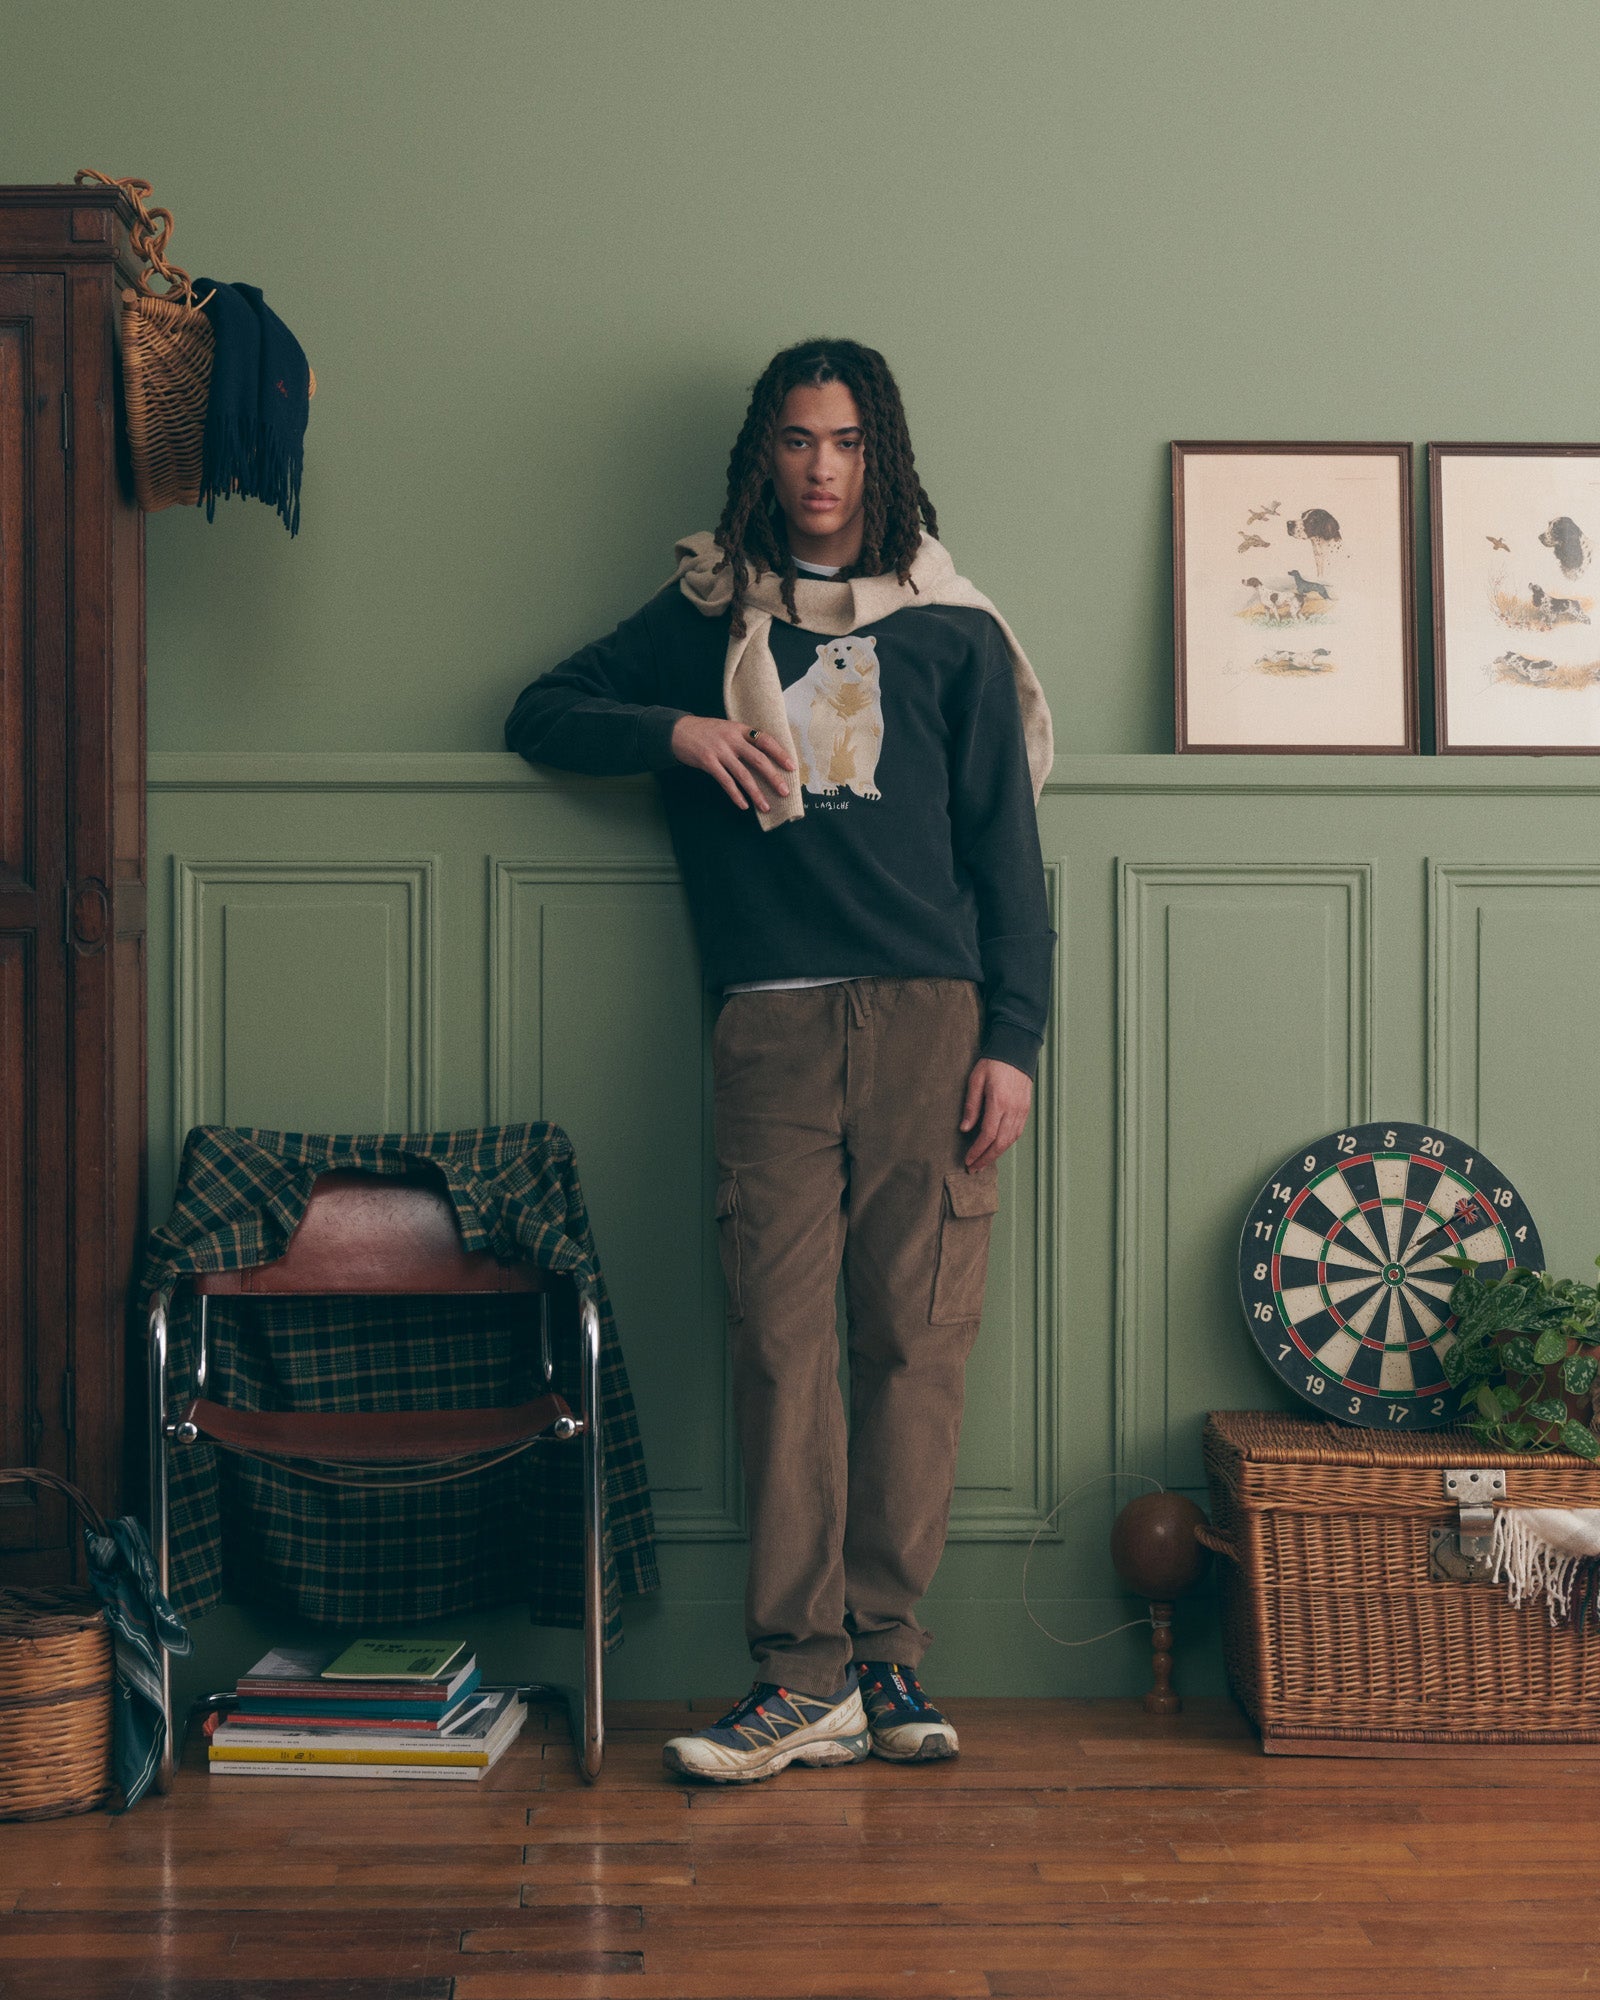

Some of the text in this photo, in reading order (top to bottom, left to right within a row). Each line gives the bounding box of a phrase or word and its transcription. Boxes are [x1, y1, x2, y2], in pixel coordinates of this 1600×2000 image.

[1338, 1134, 1357, 1155] 12
[1383, 1130, 1397, 1148] 5
[1419, 1136, 1444, 1157] 20
[1303, 1155, 1316, 1172] 9
[1464, 1157, 1474, 1175] 1
[1272, 1183, 1292, 1204] 14
[1493, 1187, 1513, 1208] 18
[1254, 1221, 1273, 1241] 11
[1515, 1225, 1528, 1243] 4
[1253, 1263, 1268, 1281] 8
[1253, 1302, 1273, 1322] 16
[1278, 1344, 1291, 1361] 7
[1305, 1375, 1325, 1395] 19
[1348, 1397, 1361, 1415] 3
[1387, 1404, 1409, 1424] 17
